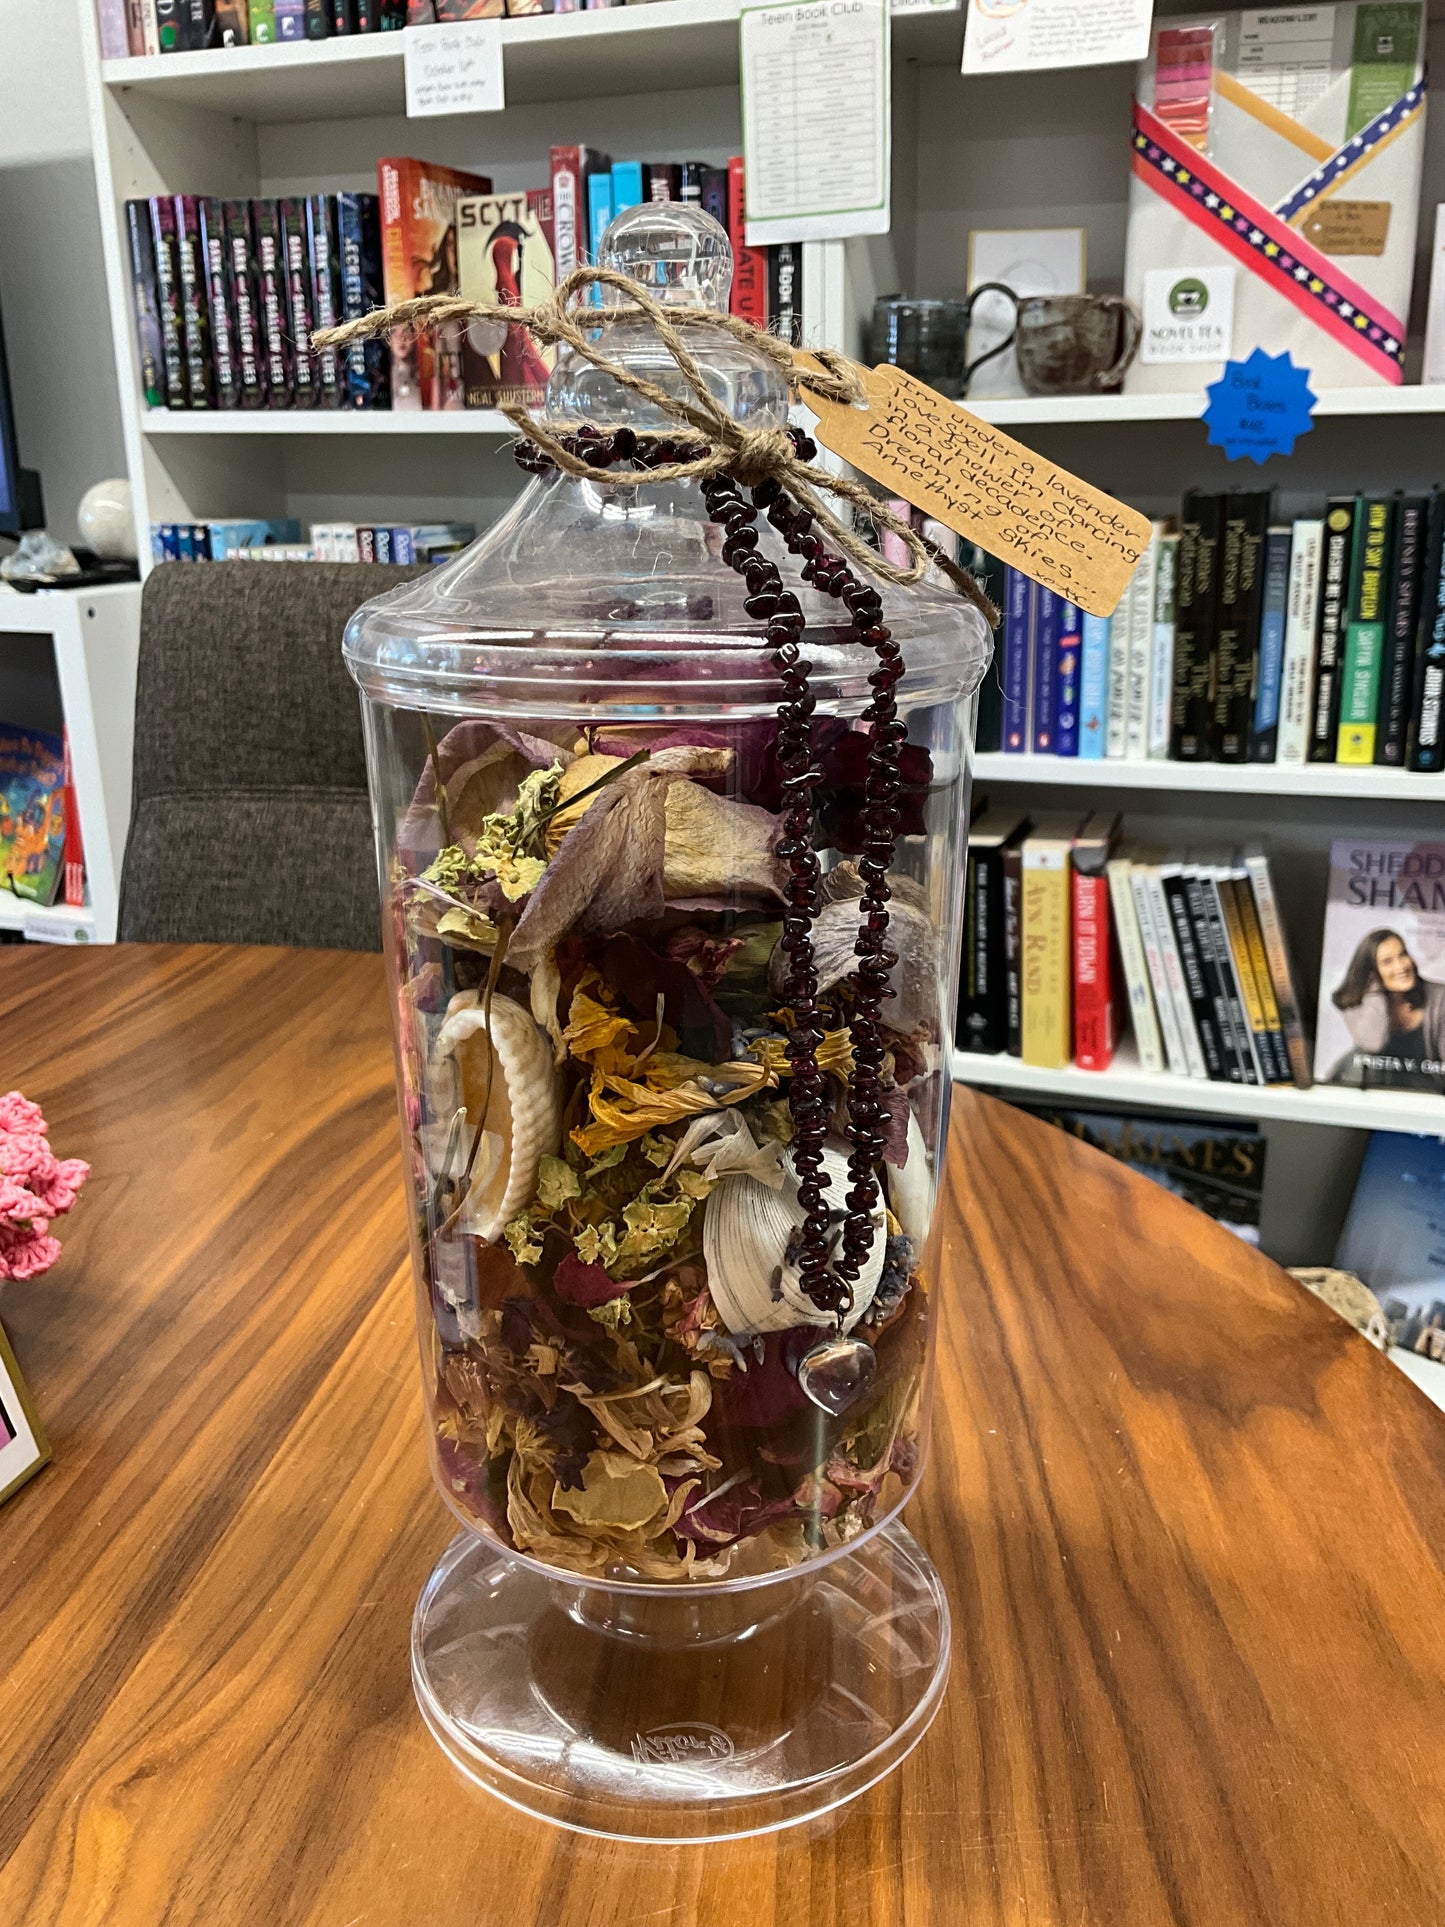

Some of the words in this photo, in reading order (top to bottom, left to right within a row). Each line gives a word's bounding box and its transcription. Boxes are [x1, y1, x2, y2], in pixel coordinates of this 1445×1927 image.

[831, 2, 864, 16] Club
[344, 236, 361, 304] ECRETS
[557, 205, 576, 276] CROW
[862, 441, 984, 520] Amethyst
[868, 423, 1002, 517] Dreaming
[1016, 524, 1049, 541] of
[915, 423, 932, 438] a
[938, 439, 1031, 498] shower
[1040, 509, 1075, 529] of
[951, 413, 1019, 458] under
[1021, 462, 1035, 475] a
[1046, 473, 1140, 540] lavender
[960, 467, 1093, 561] decadence.
[1052, 500, 1141, 564] dancing
[1026, 879, 1048, 925] AYN
[1026, 934, 1048, 997] RAND
[1078, 936, 1097, 985] DOWN
